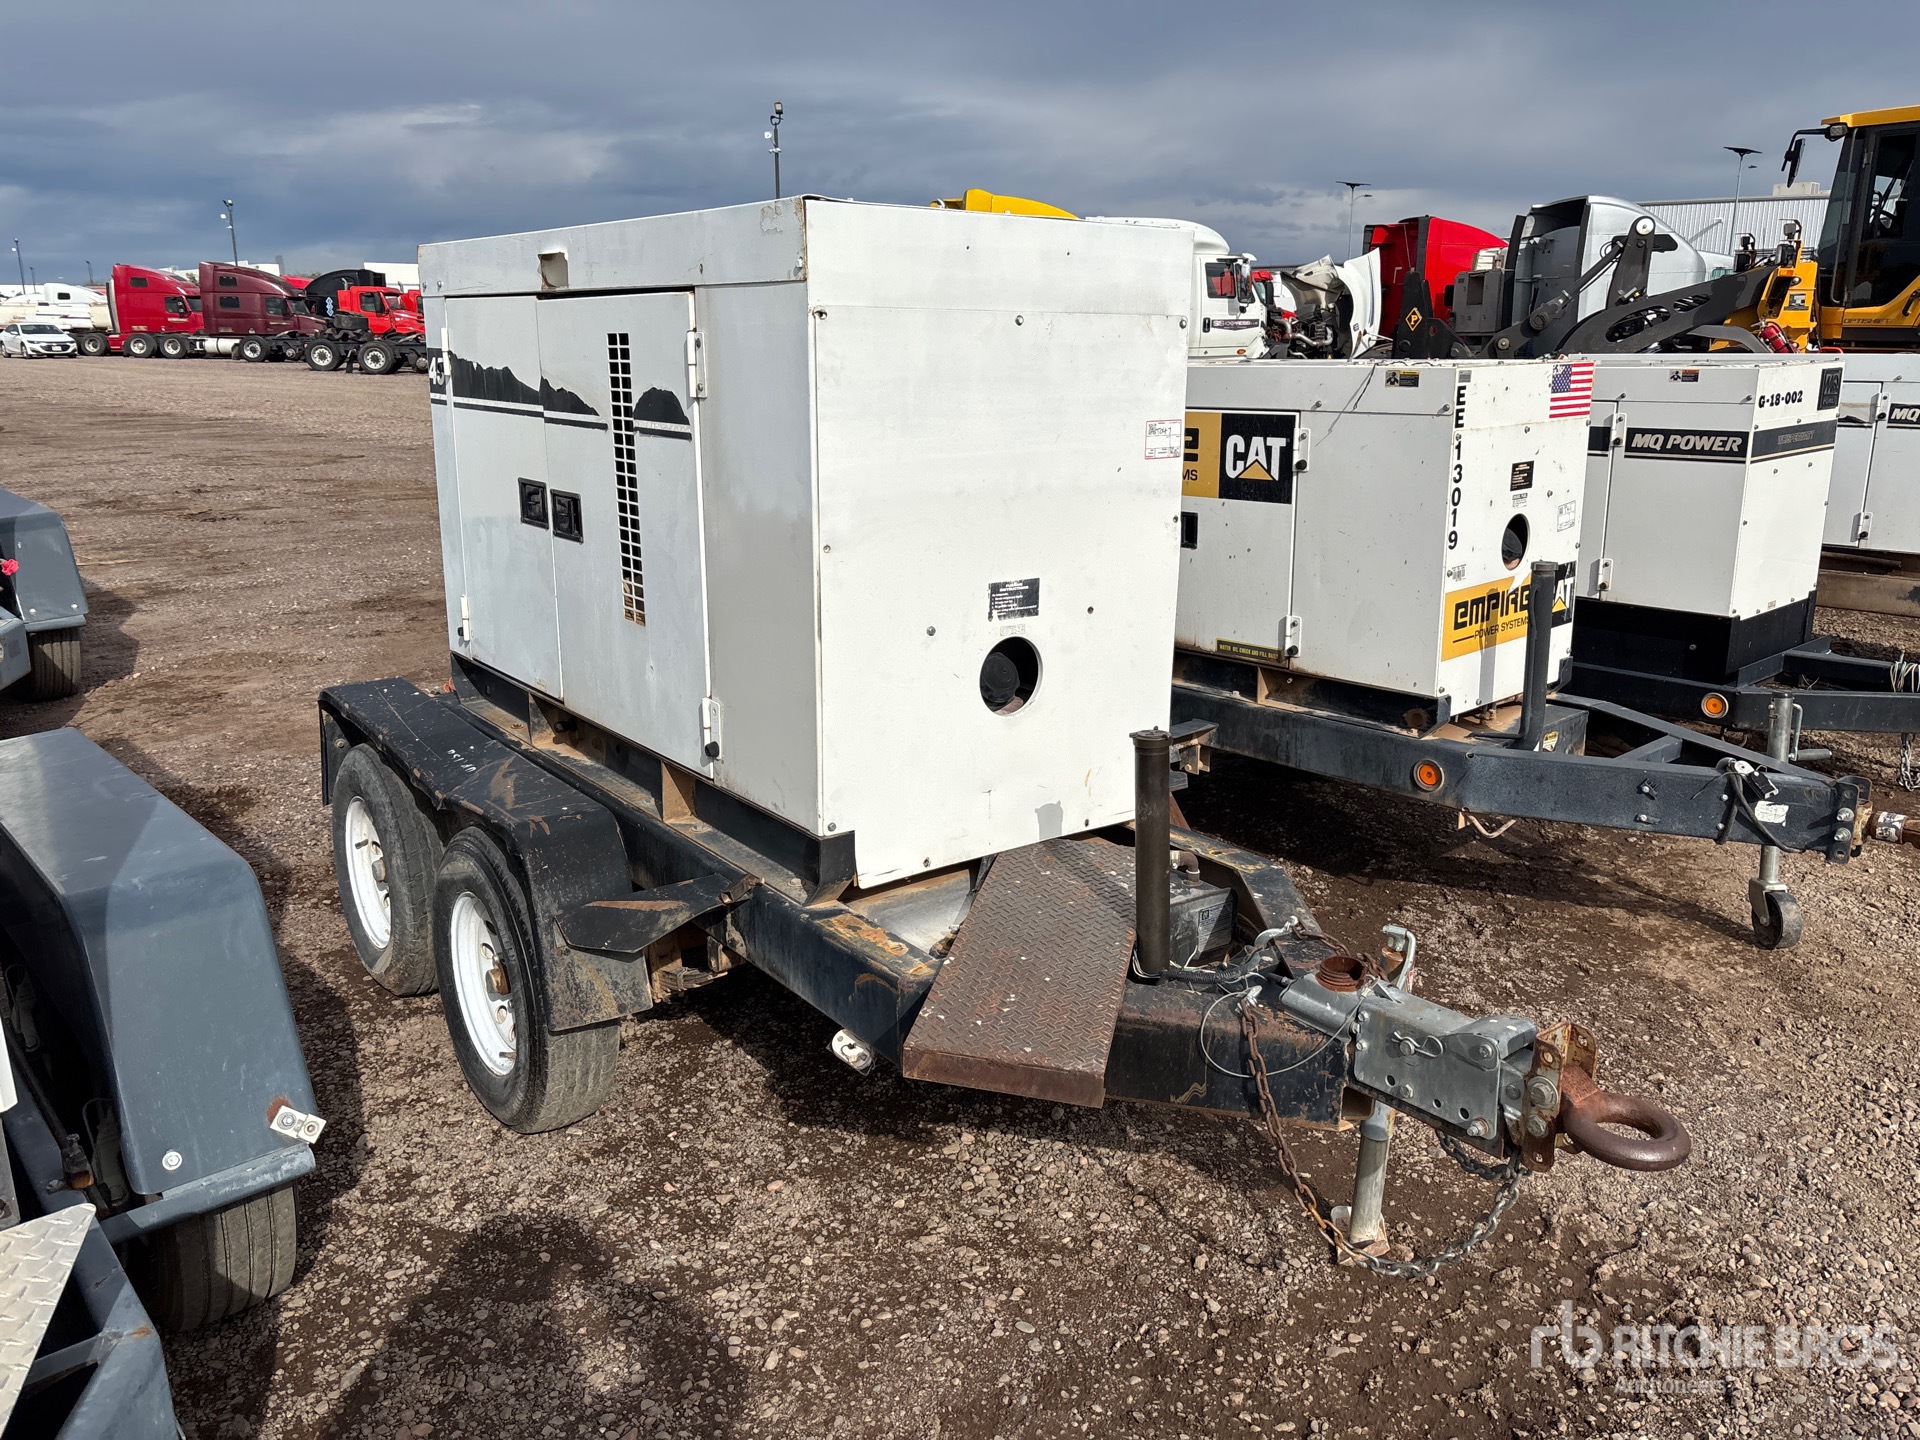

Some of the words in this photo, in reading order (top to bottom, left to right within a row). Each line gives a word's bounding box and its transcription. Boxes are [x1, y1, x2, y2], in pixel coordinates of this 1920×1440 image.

[1890, 407, 1920, 423] MQ
[1631, 433, 1665, 451] MQ
[1666, 434, 1743, 452] POWER
[1225, 434, 1287, 482] CAT
[1474, 625, 1499, 640] POWER
